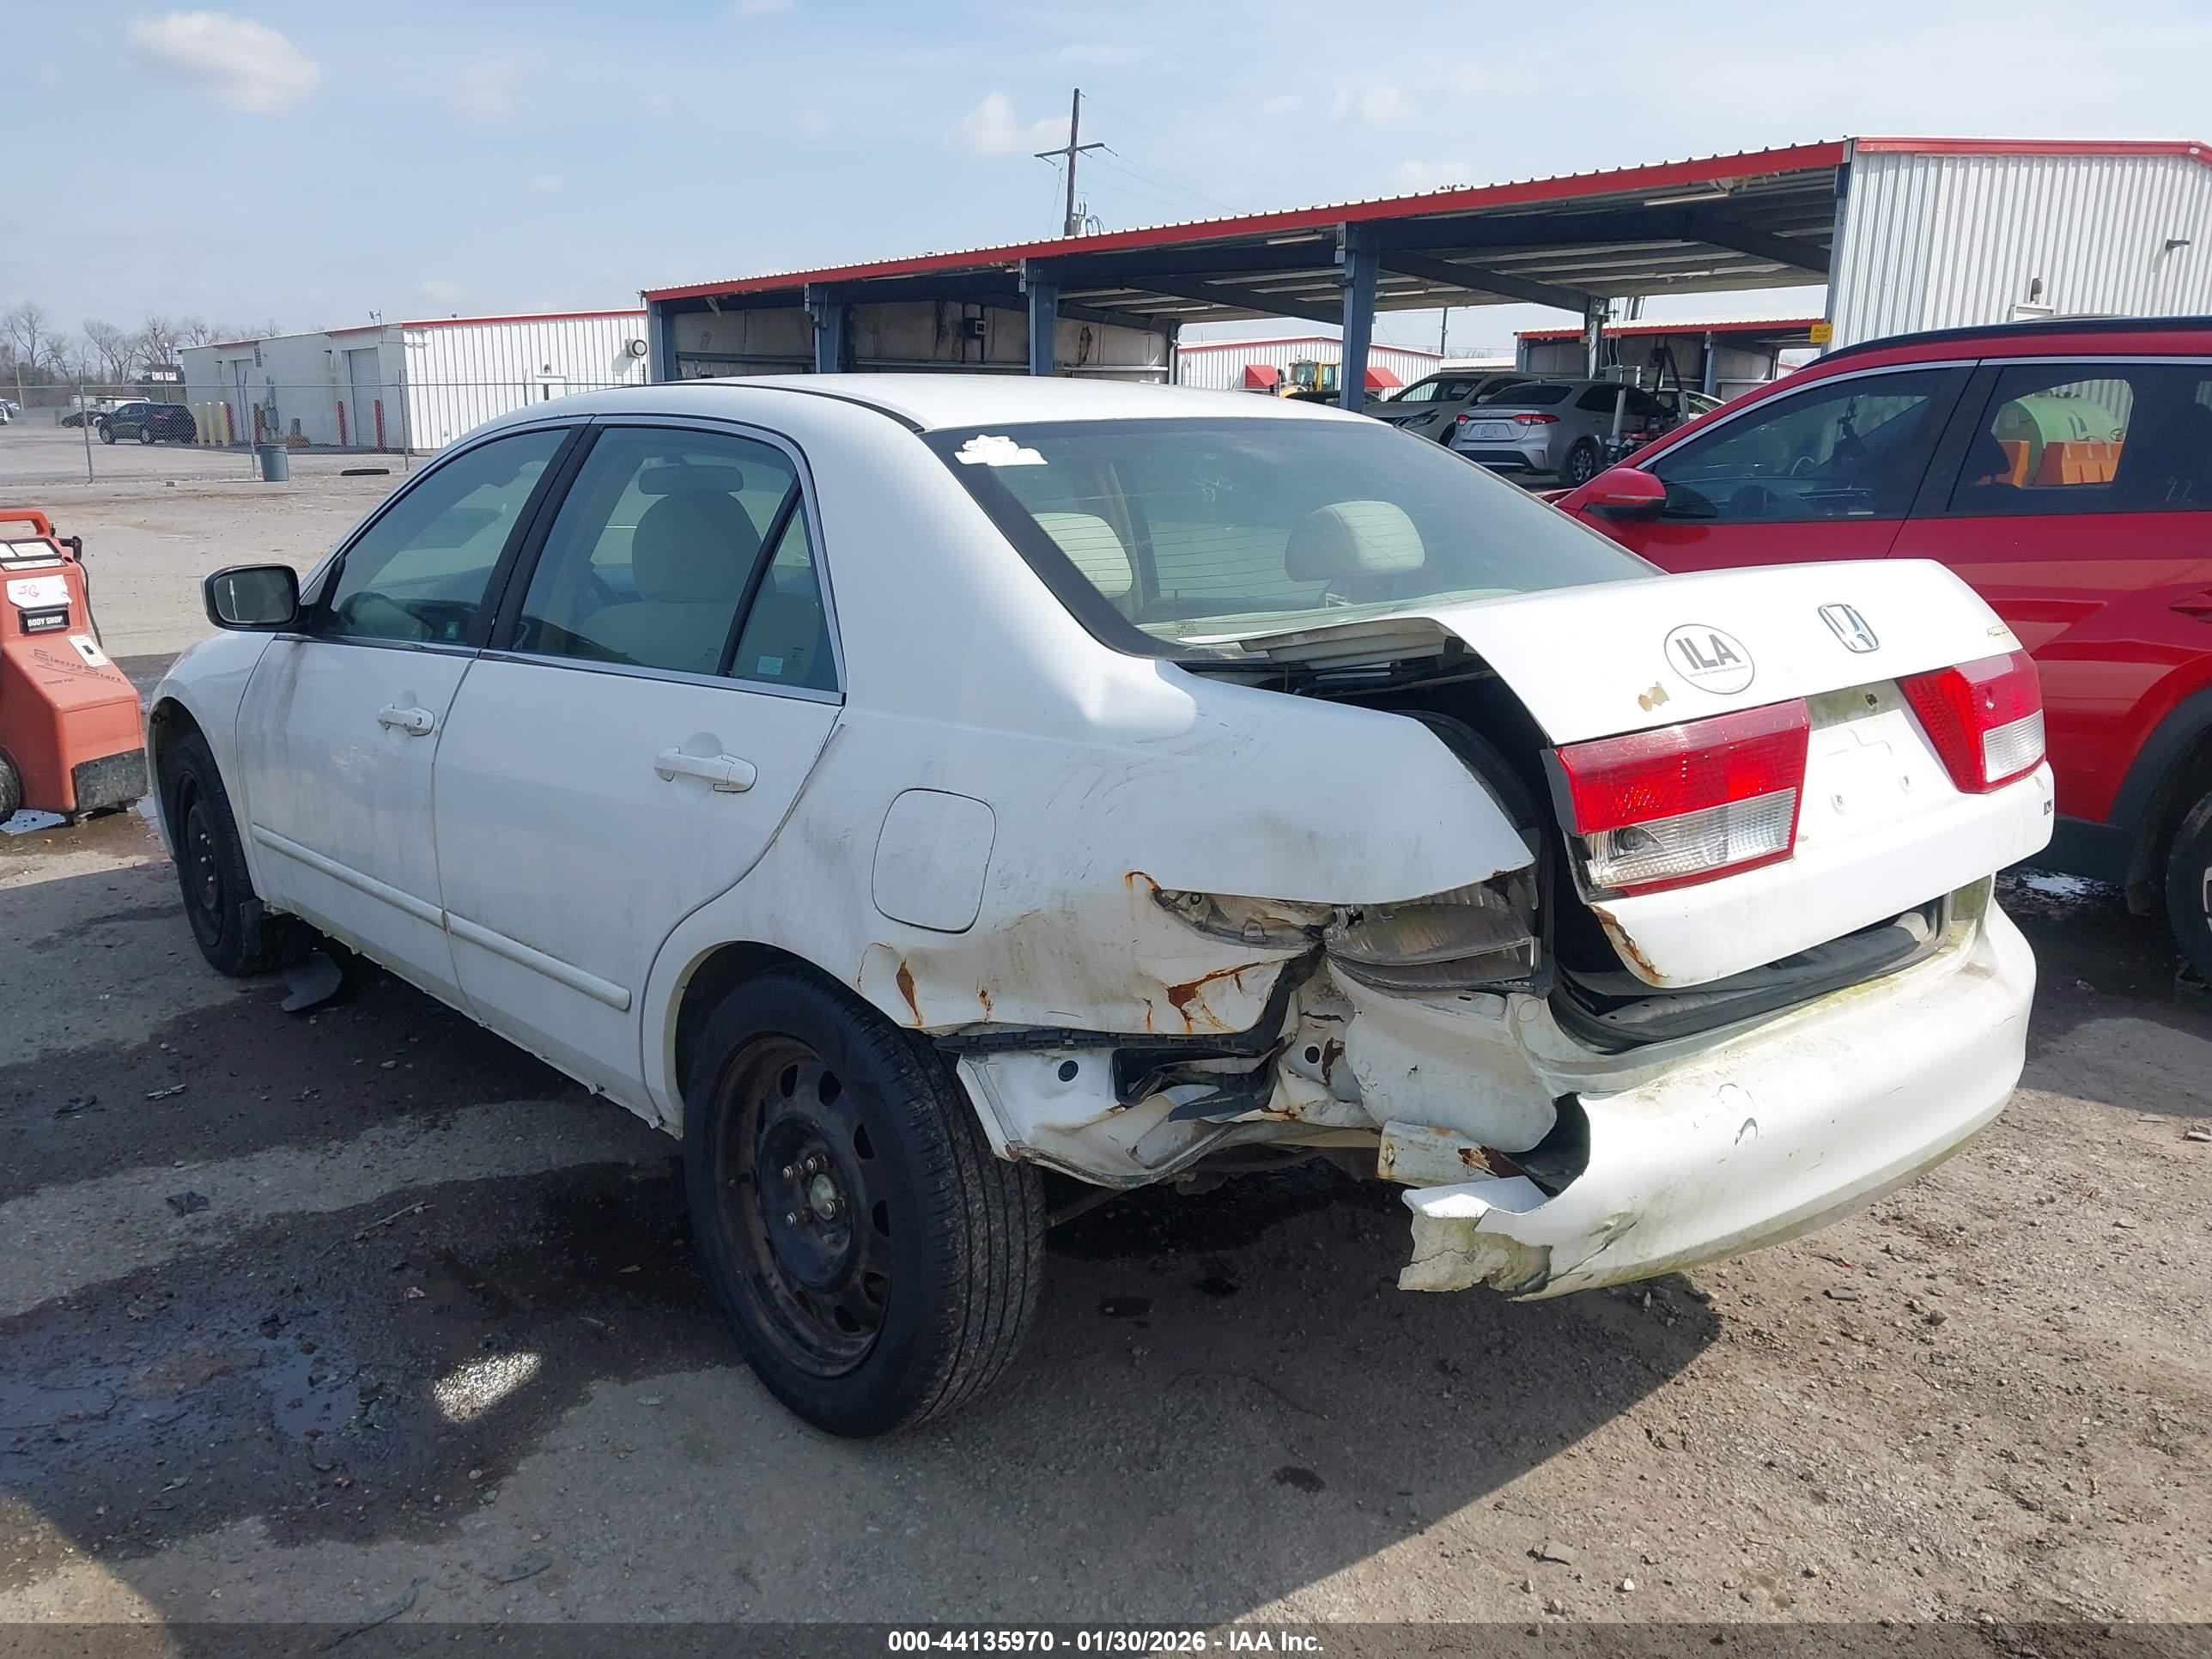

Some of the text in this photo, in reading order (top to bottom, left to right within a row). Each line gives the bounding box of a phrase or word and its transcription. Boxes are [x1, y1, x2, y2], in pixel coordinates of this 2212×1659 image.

[27, 616, 63, 627] BODY SHOP
[1674, 634, 1741, 670] ILA
